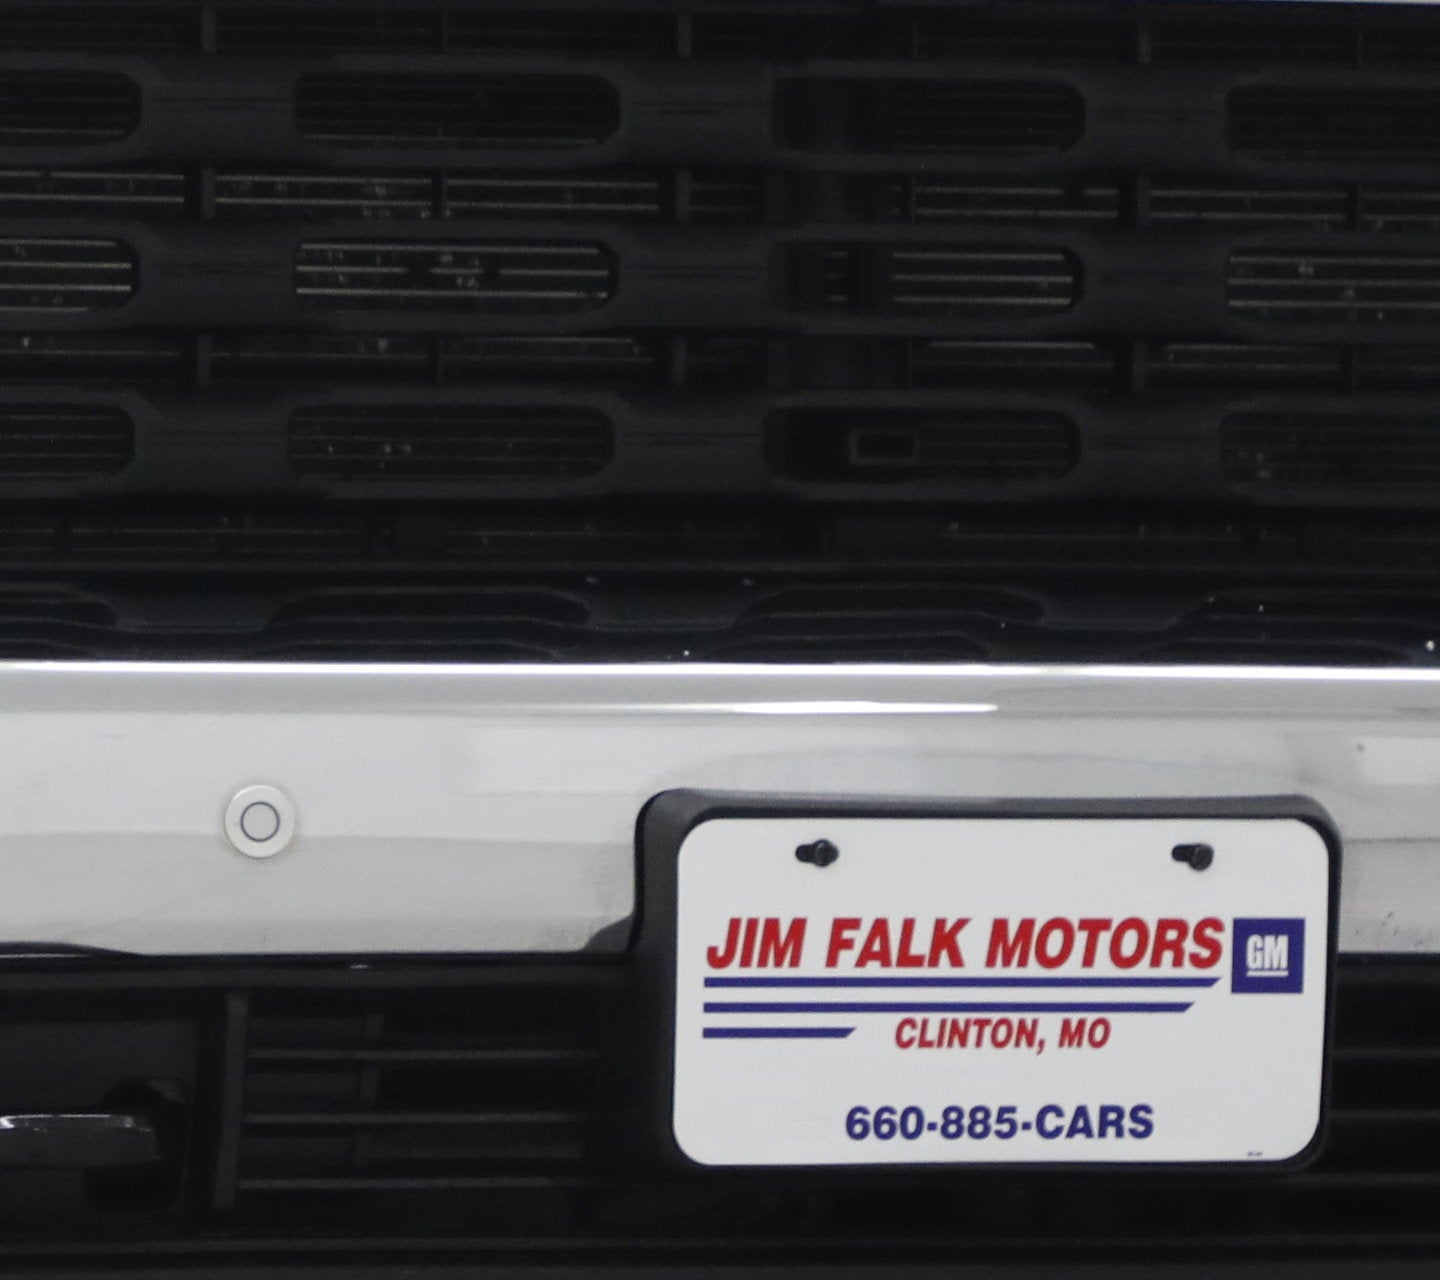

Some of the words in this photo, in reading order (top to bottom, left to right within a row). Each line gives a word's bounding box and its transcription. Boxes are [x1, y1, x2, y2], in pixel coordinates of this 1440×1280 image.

[706, 917, 808, 970] JIM
[825, 917, 969, 969] FALK
[985, 917, 1225, 970] MOTORS
[1246, 934, 1289, 977] GM
[894, 1017, 1045, 1055] CLINTON,
[1059, 1017, 1111, 1050] MO
[845, 1103, 1155, 1141] 660-885-CARS
